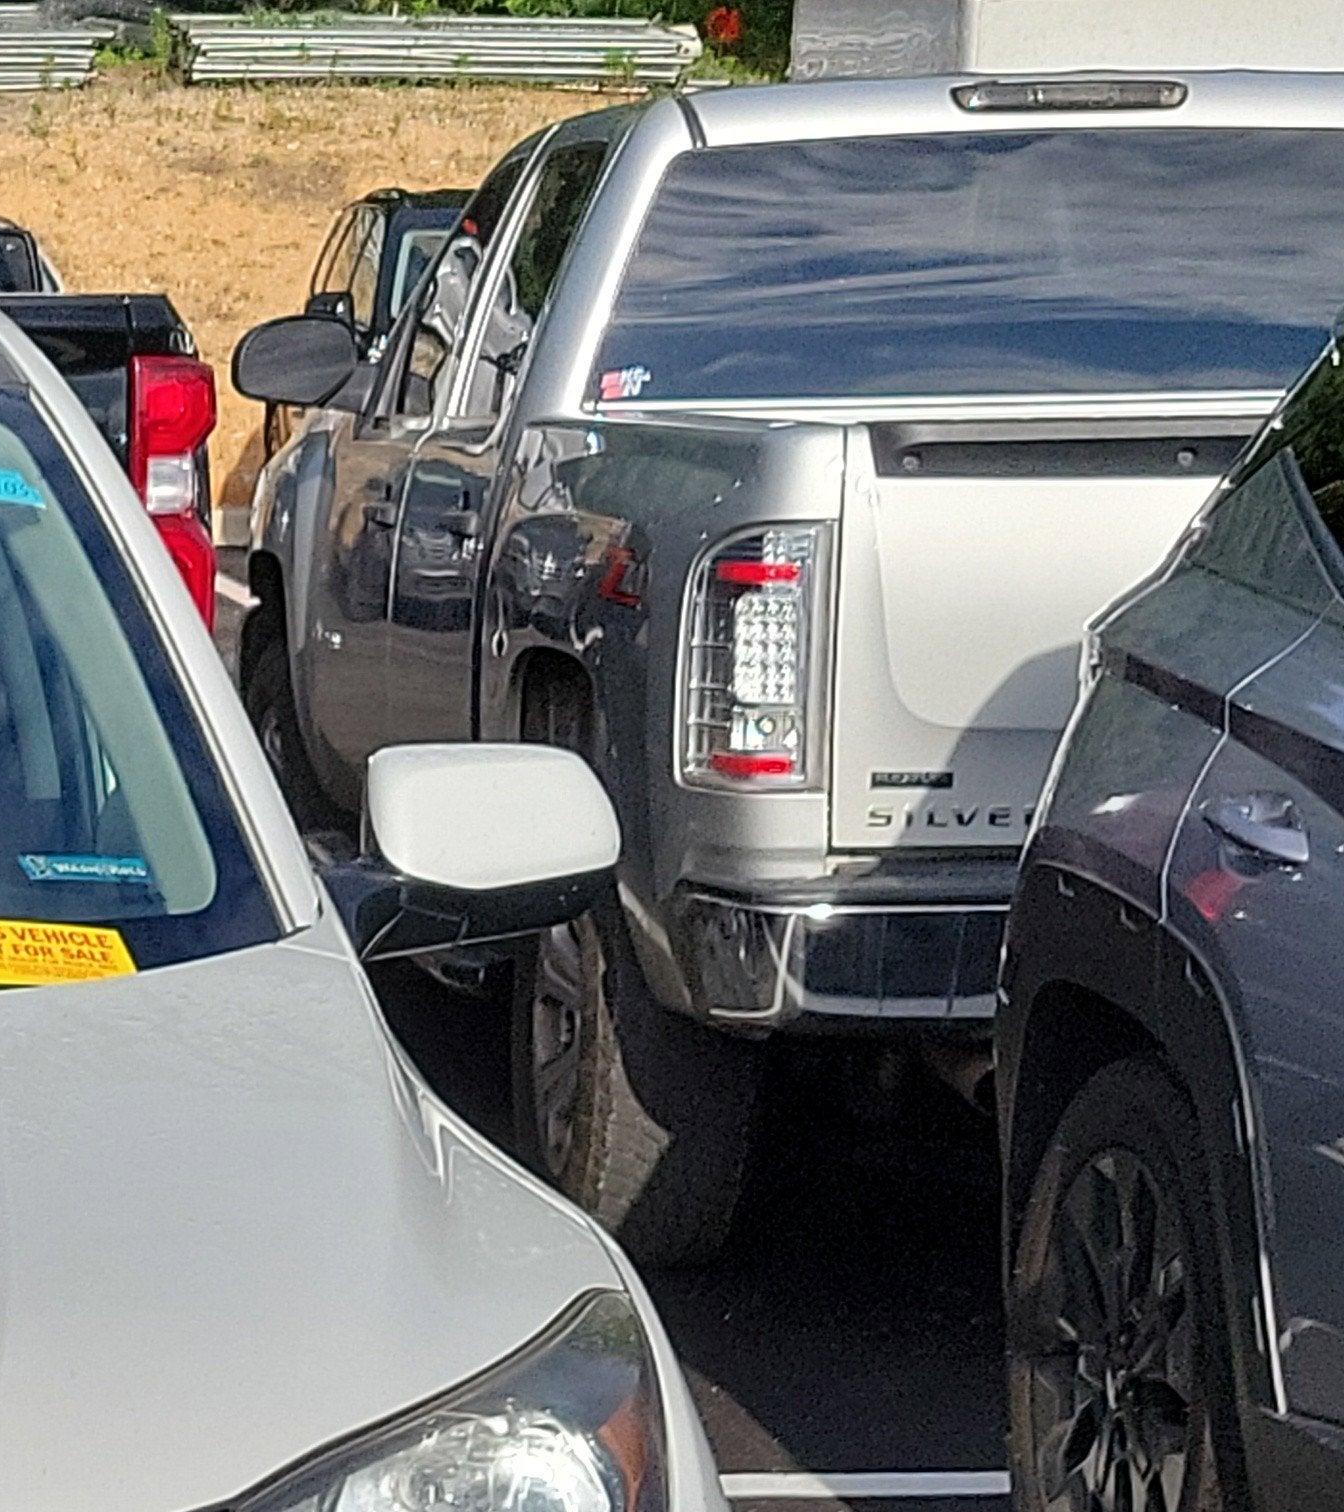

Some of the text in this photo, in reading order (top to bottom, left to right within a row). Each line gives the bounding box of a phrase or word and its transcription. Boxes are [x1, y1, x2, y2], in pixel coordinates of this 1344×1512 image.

[11, 927, 113, 949] VEHICLE
[12, 943, 53, 958] FOR
[60, 946, 111, 962] SALE
